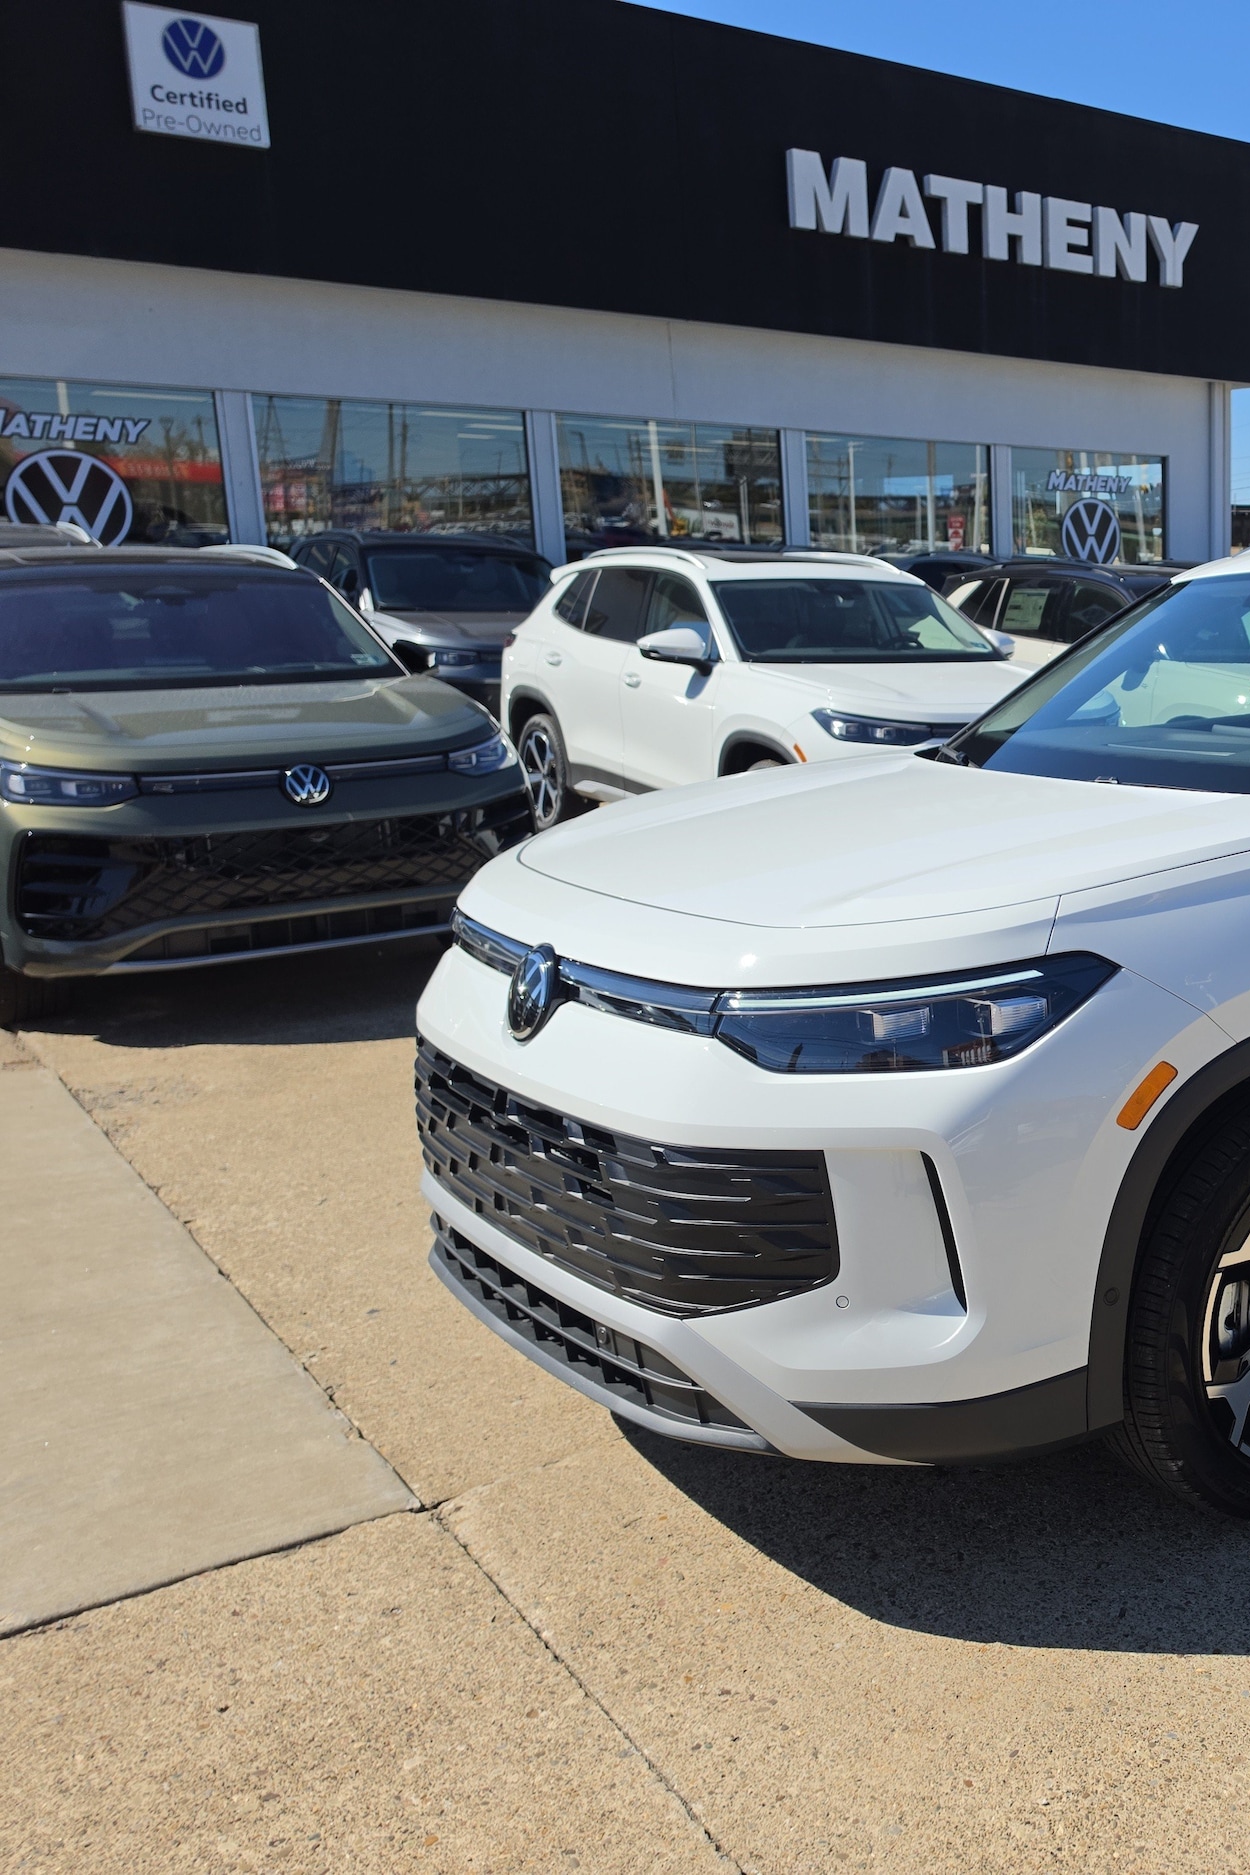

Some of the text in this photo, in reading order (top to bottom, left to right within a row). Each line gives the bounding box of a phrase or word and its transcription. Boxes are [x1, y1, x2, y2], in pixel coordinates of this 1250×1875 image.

[150, 84, 248, 114] Certified
[141, 107, 262, 142] Pre-Owned
[786, 147, 1200, 289] MATHENY
[0, 407, 150, 444] ATHENY
[1046, 470, 1132, 493] MATHENY
